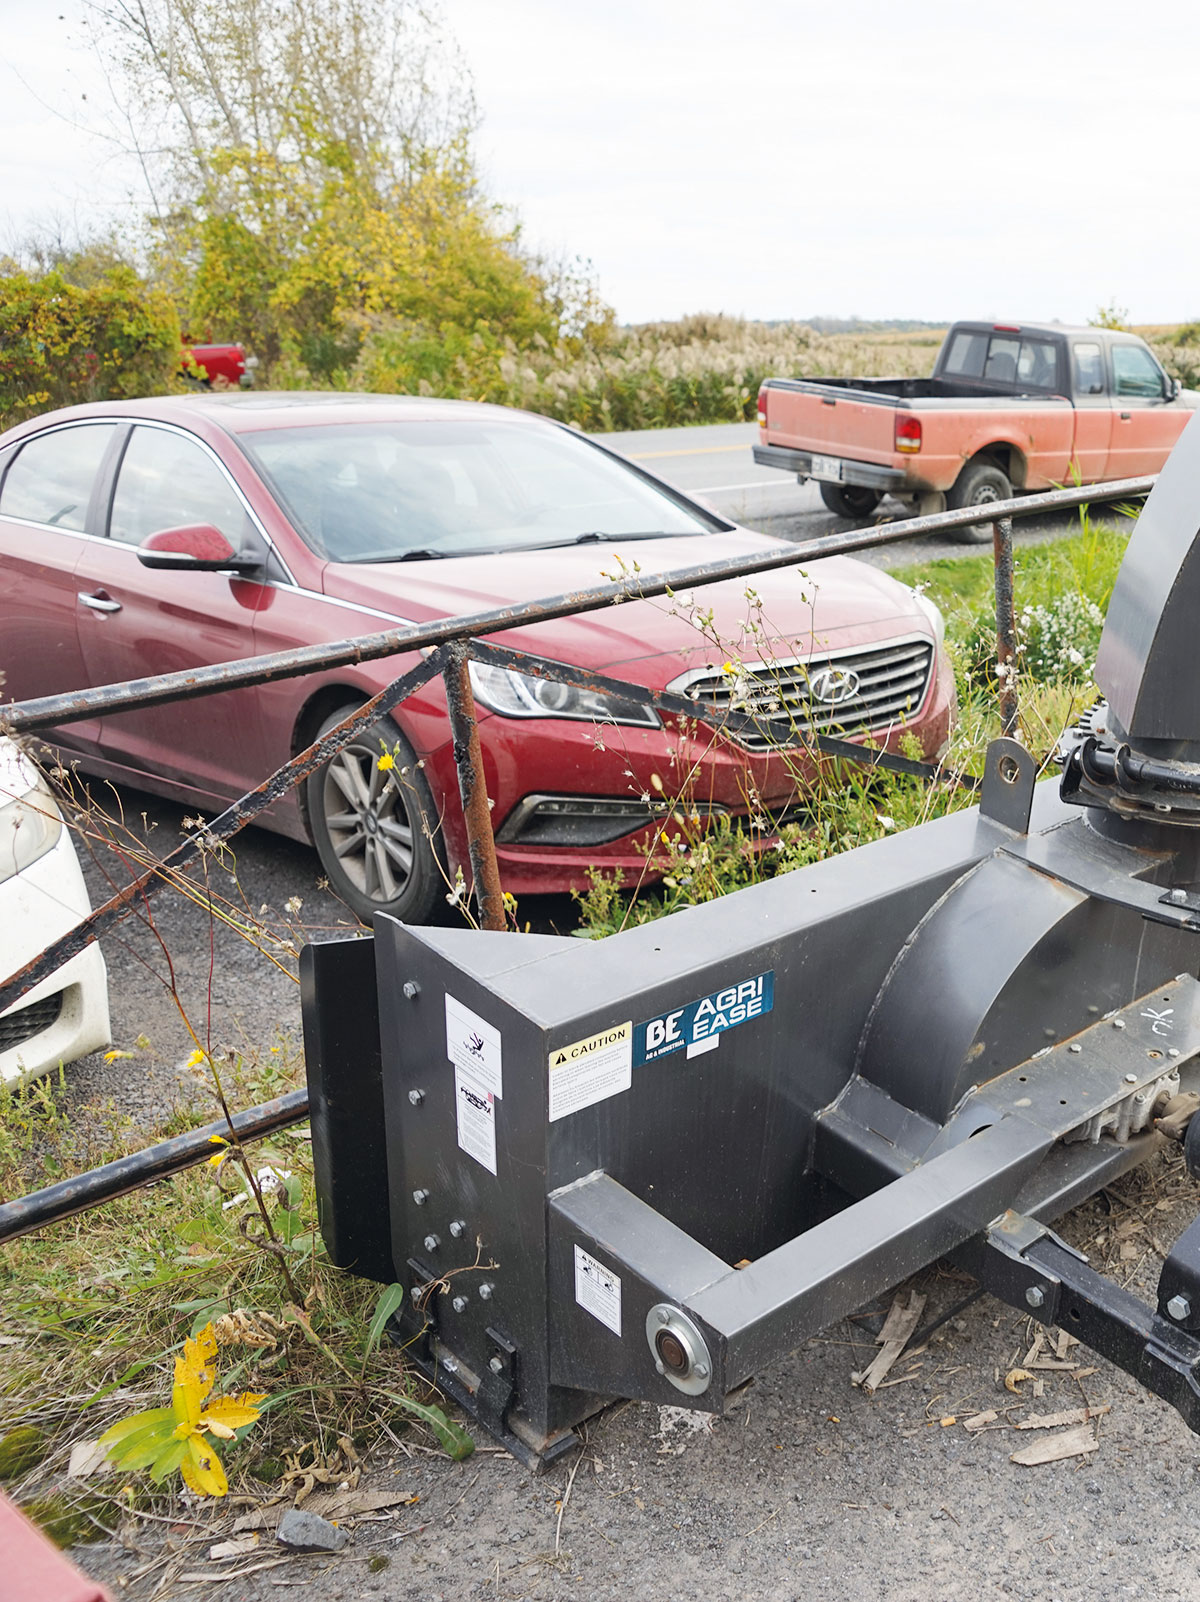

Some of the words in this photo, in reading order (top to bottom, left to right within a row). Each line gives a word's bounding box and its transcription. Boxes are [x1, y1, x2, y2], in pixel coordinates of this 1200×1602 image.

[692, 996, 763, 1041] EASE
[693, 975, 763, 1023] AGRI
[571, 1029, 626, 1058] CAUTION
[646, 1009, 685, 1051] BE
